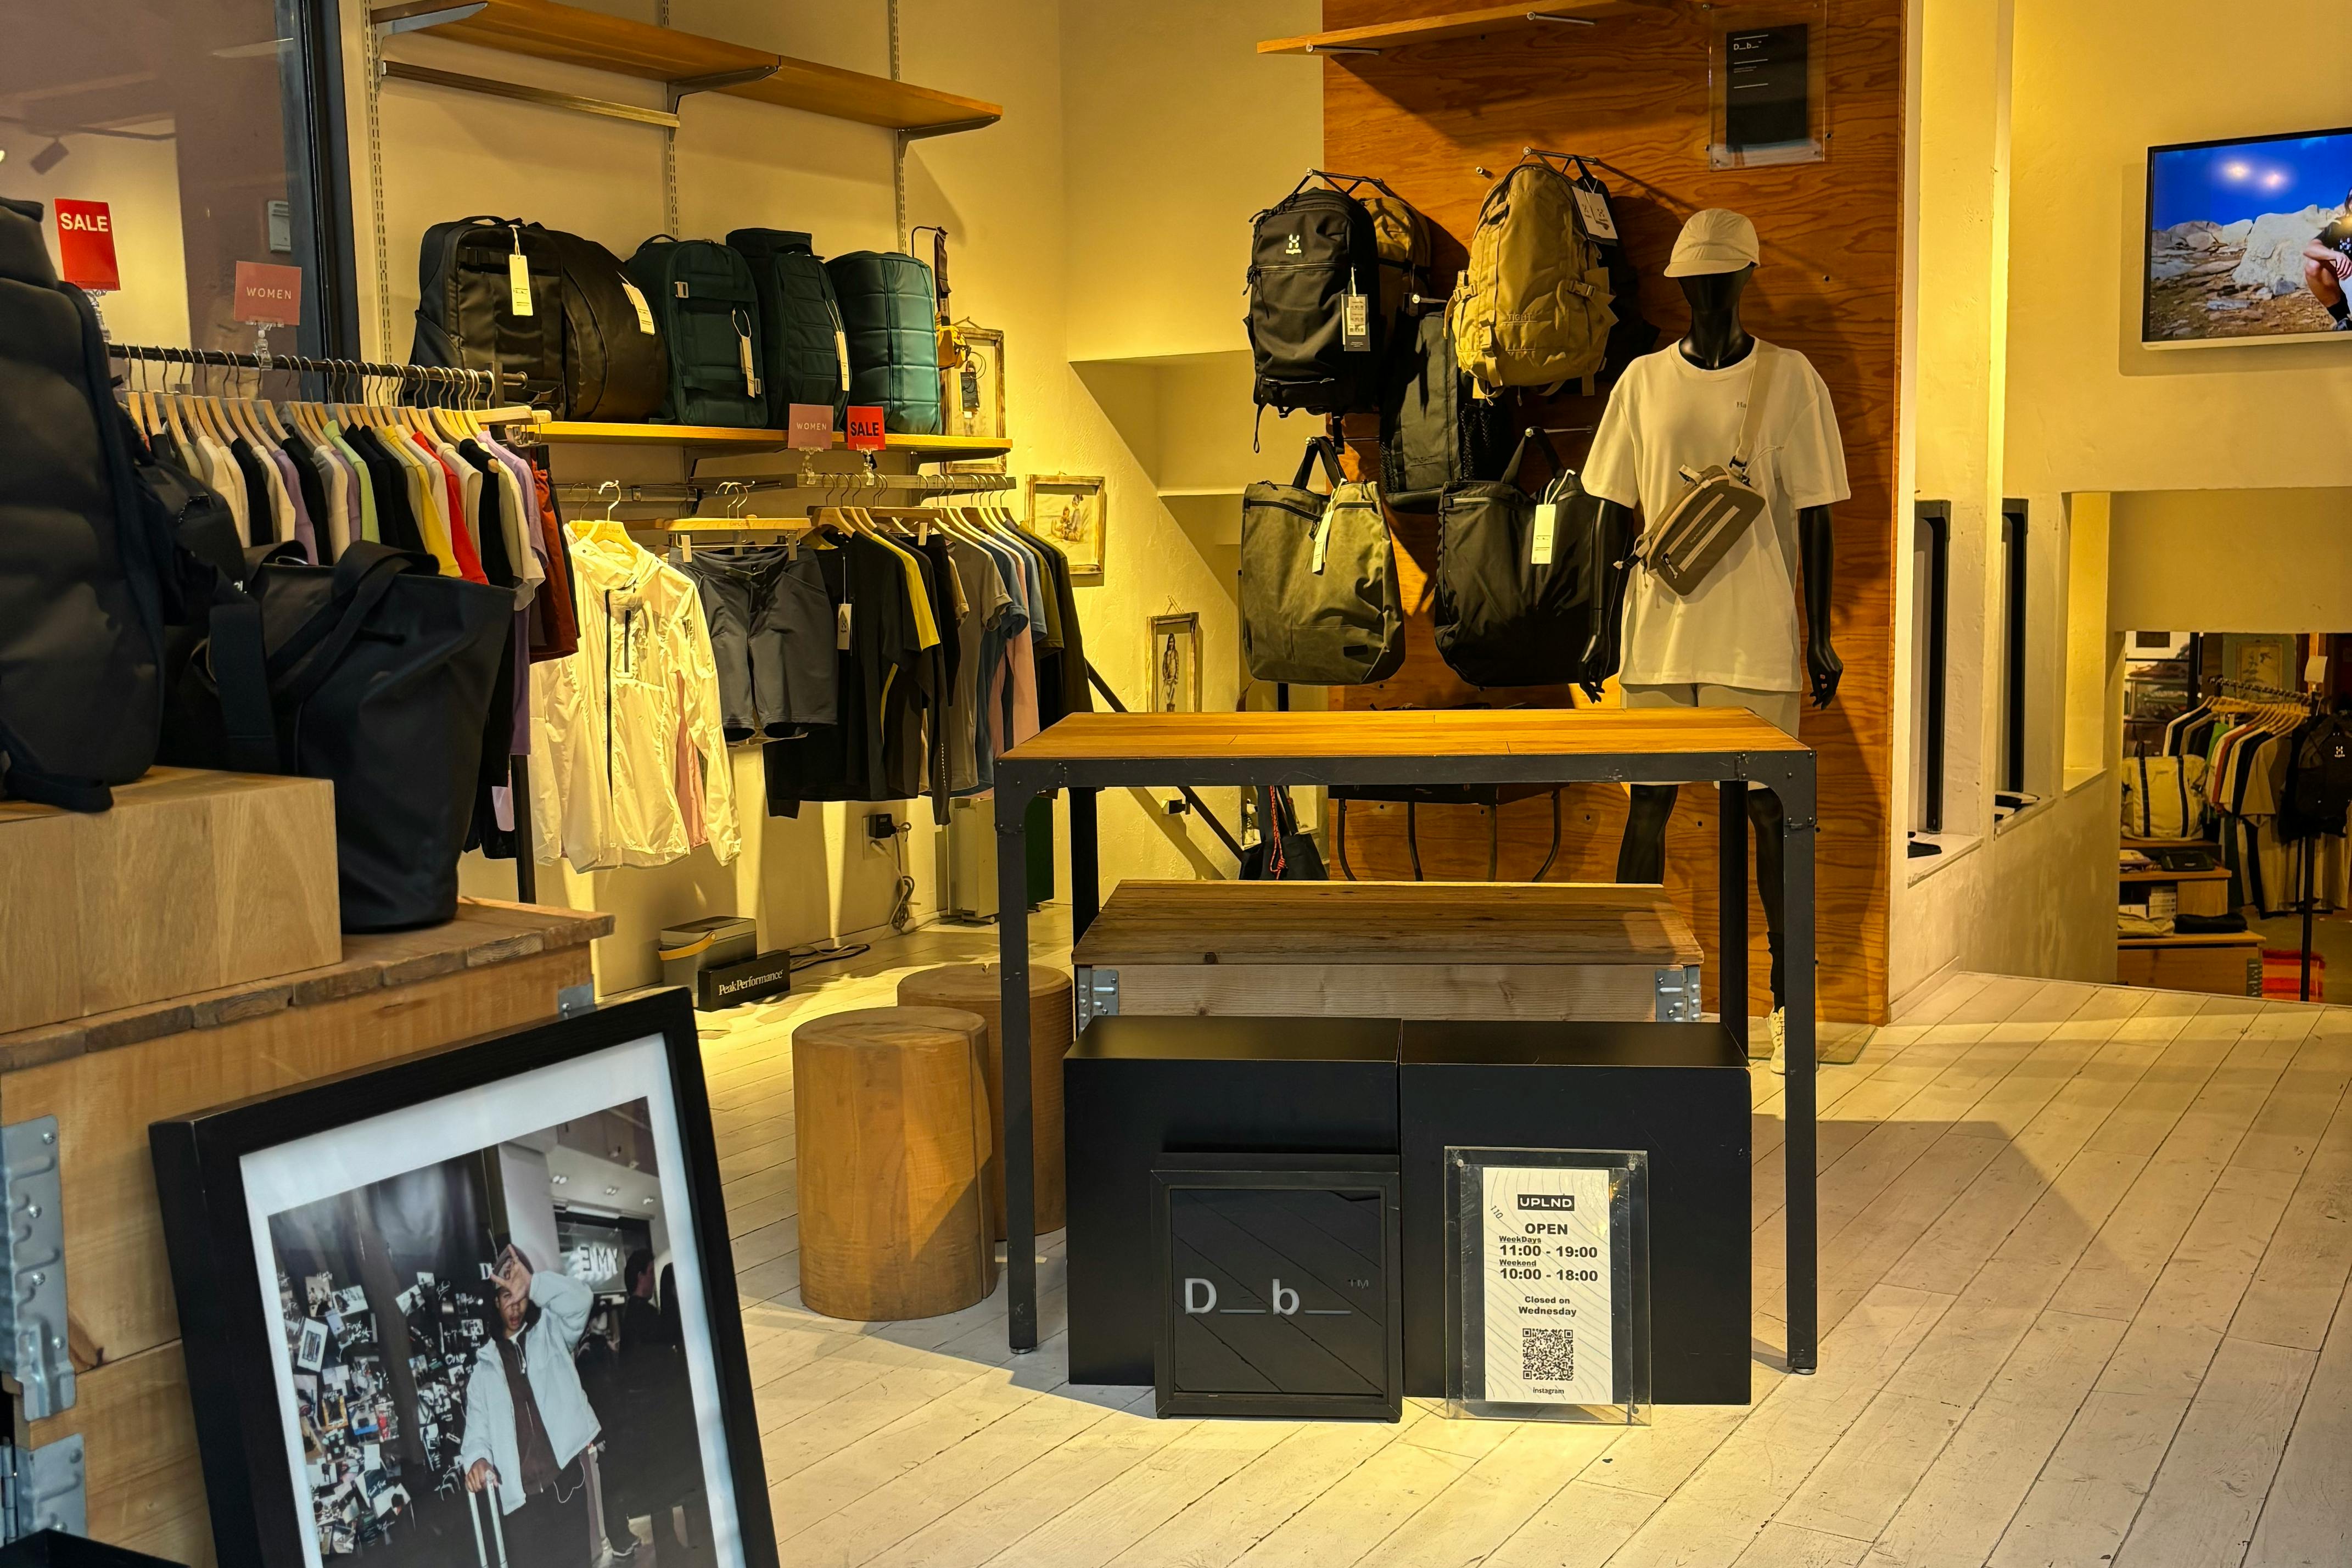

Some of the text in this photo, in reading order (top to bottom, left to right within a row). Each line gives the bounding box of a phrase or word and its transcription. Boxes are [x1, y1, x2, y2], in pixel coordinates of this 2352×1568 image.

[60, 212, 109, 232] SALE
[246, 286, 292, 300] WOMEN
[1508, 313, 1532, 321] TIGHT
[796, 422, 827, 430] WOMEN
[850, 421, 880, 436] SALE
[1520, 1197, 1572, 1208] UPLND
[1525, 1223, 1568, 1235] OPEN
[1499, 1235, 1542, 1244] WeekDays
[1500, 1245, 1542, 1257] 11:00
[1556, 1246, 1598, 1258] 19:00
[1500, 1268, 1542, 1280] 10:00
[1556, 1269, 1599, 1281] 18:00
[1525, 1296, 1556, 1304] Closed
[1519, 1306, 1577, 1317] Wednesday
